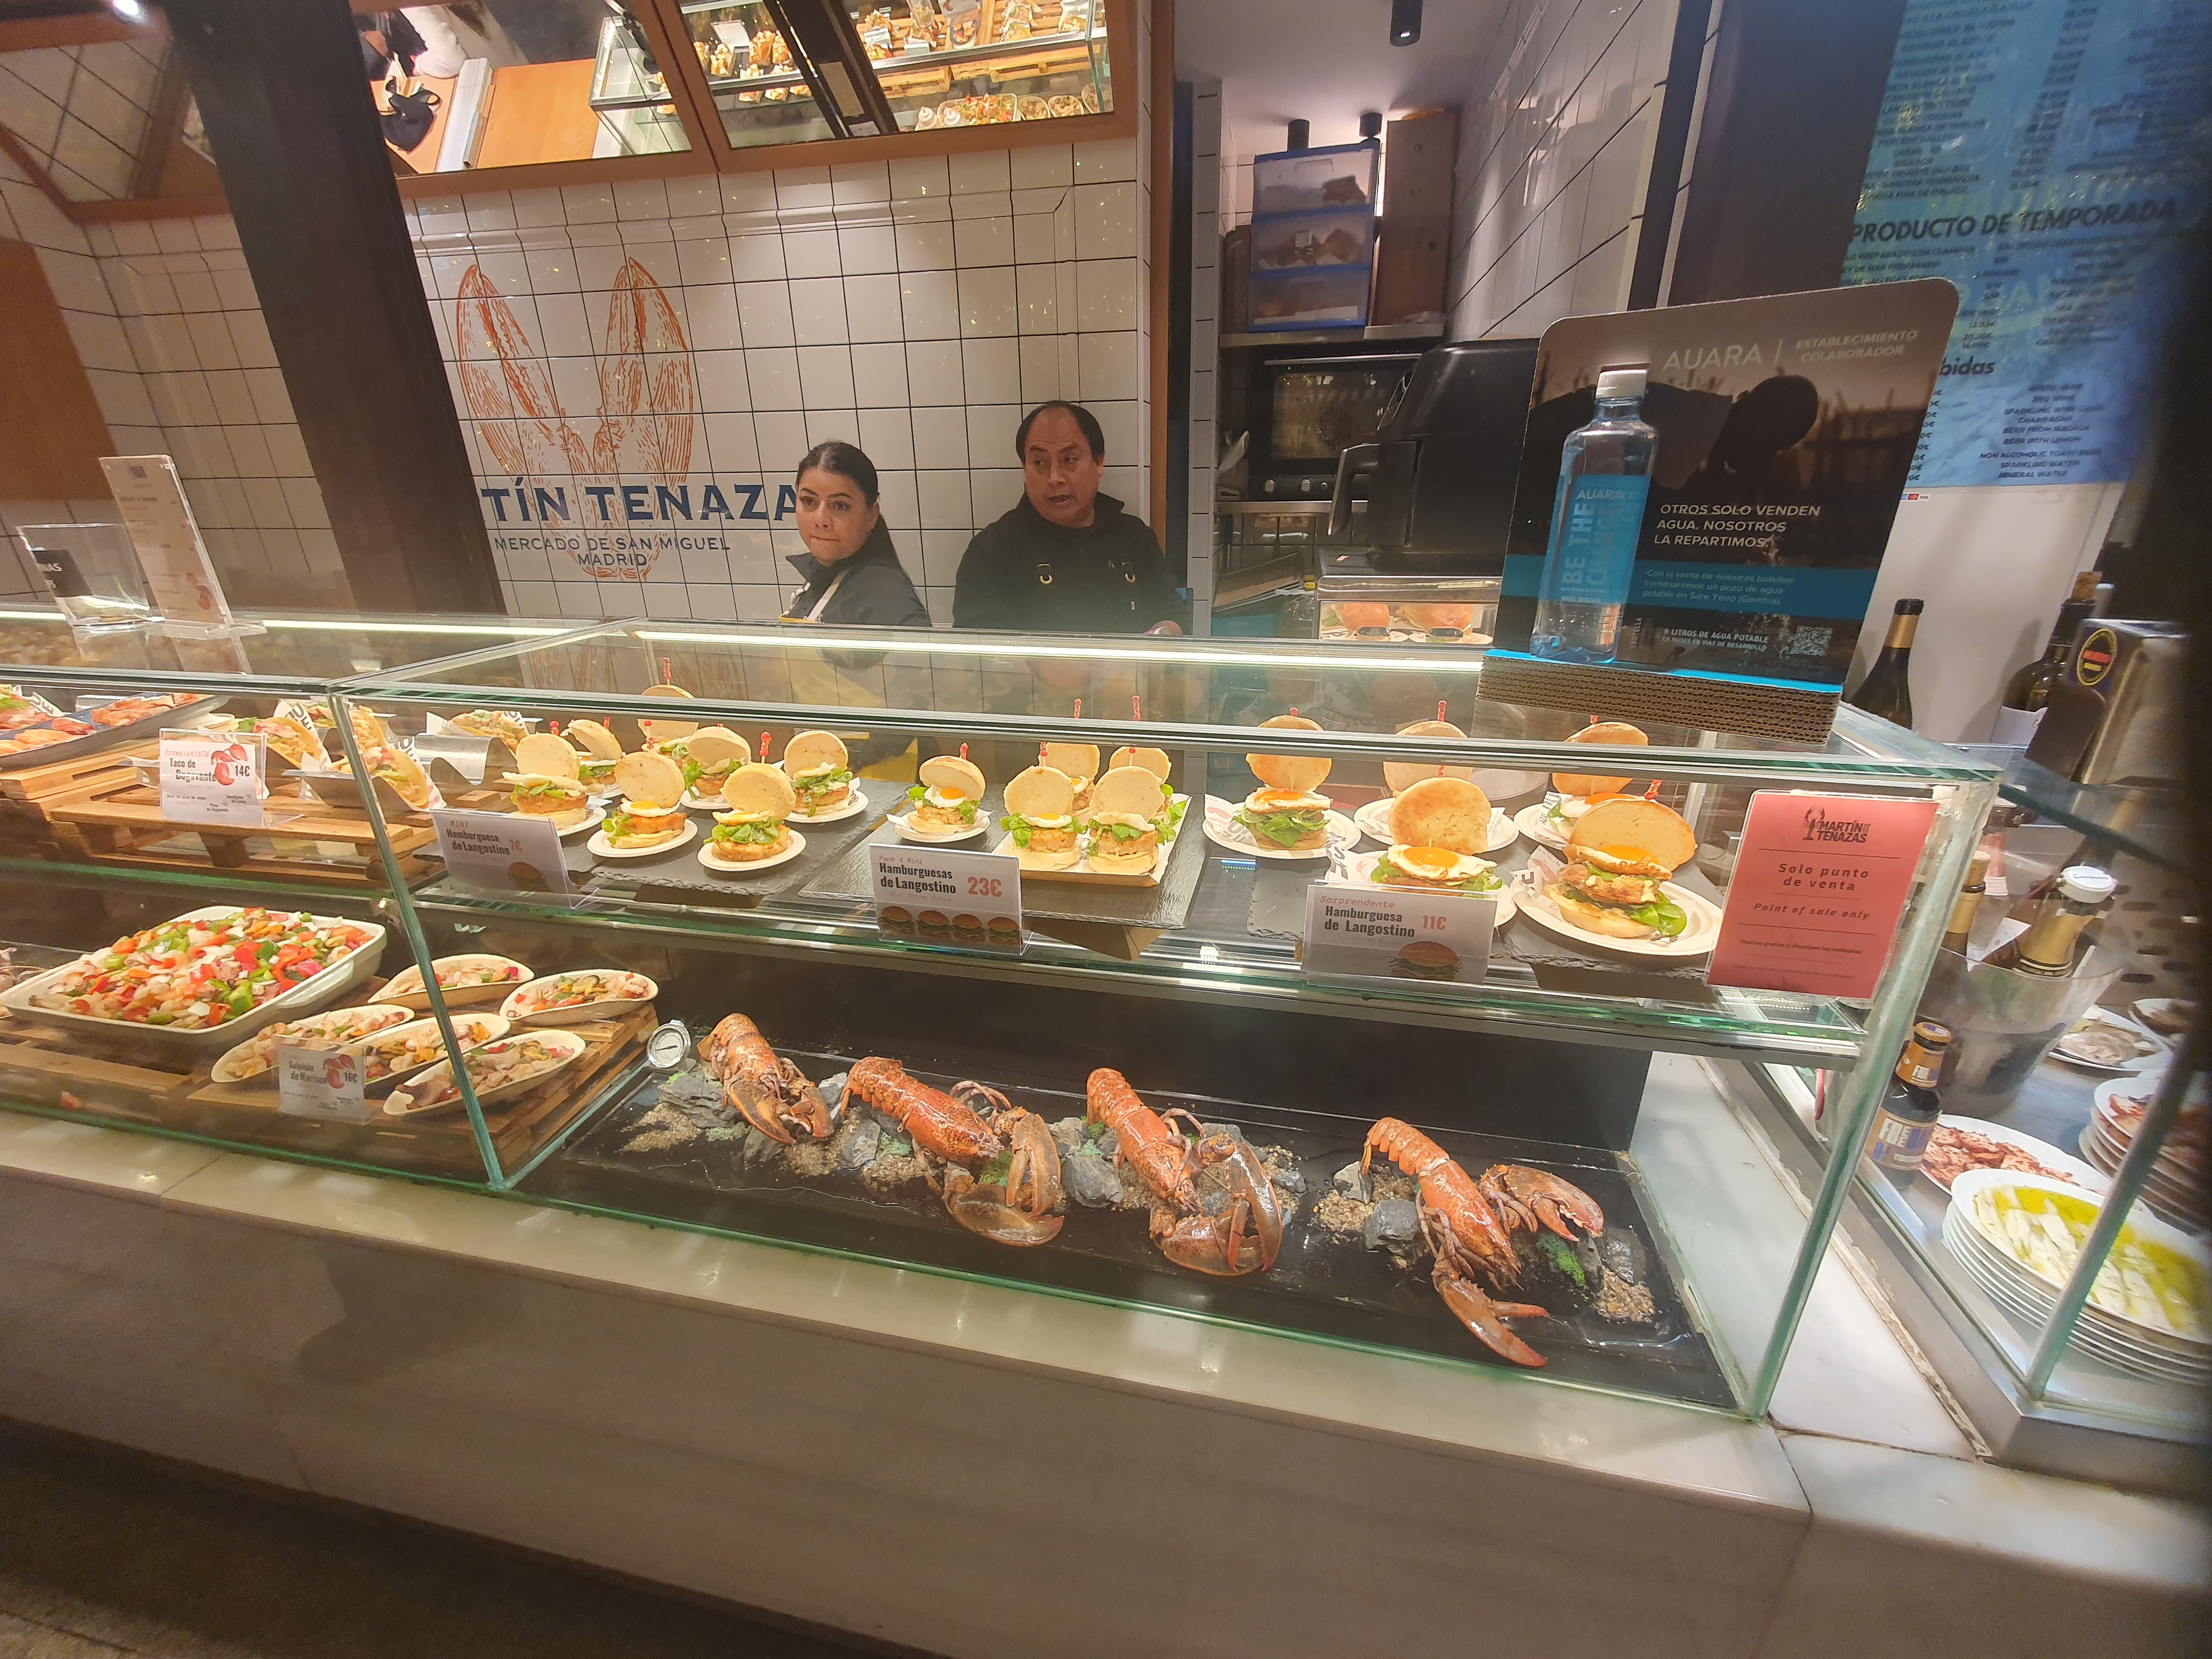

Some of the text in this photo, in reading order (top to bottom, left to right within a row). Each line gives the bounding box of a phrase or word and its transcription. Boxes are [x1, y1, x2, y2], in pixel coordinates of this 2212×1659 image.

[1853, 215, 1975, 242] PRODUCTO
[1981, 214, 2010, 235] DE
[2018, 198, 2176, 232] TEMPORADA
[1796, 330, 1918, 349] ESTABLECIMIENTO
[1662, 343, 1763, 372] AUARA
[1801, 345, 1905, 361] COLABORADOR
[1940, 355, 1996, 376] bidas
[1576, 489, 1625, 500] AUARA
[1660, 504, 1822, 517] OTROS SOLO VENDEN
[1567, 503, 1595, 547] THE
[1656, 519, 1788, 533] AGUA. NOSOTROS
[494, 537, 731, 551] MERCADO DE SAN MIGUEL
[1654, 534, 1769, 547] LA REPARTIMOS.
[577, 553, 648, 567] MADRID
[1562, 556, 1586, 584] BE
[1702, 572, 1713, 580] de
[1716, 574, 1754, 582] nuestras
[1757, 575, 1795, 585] botellas
[1642, 589, 1674, 598] potable
[1689, 591, 1710, 600] Sare
[1712, 593, 1737, 602] Yerro
[1644, 580, 1704, 590] construiremos
[1719, 584, 1743, 593] pozo
[1759, 587, 1784, 596] agua
[1630, 617, 1643, 645] BOTELLA
[1671, 628, 1697, 637] LITROS
[1699, 631, 1708, 639] DE
[1710, 632, 1731, 641] AGUA
[1733, 633, 1770, 644] POTABLE
[1727, 641, 1767, 652] DESARROLLO
[169, 757, 196, 768] Taco de
[235, 765, 251, 777] 14€
[450, 819, 469, 829] MINI
[1819, 820, 1863, 833] MARTÍN
[446, 829, 500, 842] Hamburguesa
[1816, 830, 1868, 843] TENAZAS
[452, 840, 464, 851] de
[464, 840, 510, 856] Langostino
[879, 862, 953, 879] Hamburguesas
[1778, 863, 1869, 879] Solo punto
[880, 876, 1002, 897] de Langostino 23€
[1783, 876, 1855, 891] de venta
[1320, 895, 1395, 909] Sorprendente
[1324, 905, 1447, 930] Hamburguesa 11€
[1753, 902, 1870, 921] Point of sale only
[1324, 918, 1415, 938] de Langostino
[290, 1071, 300, 1080] de
